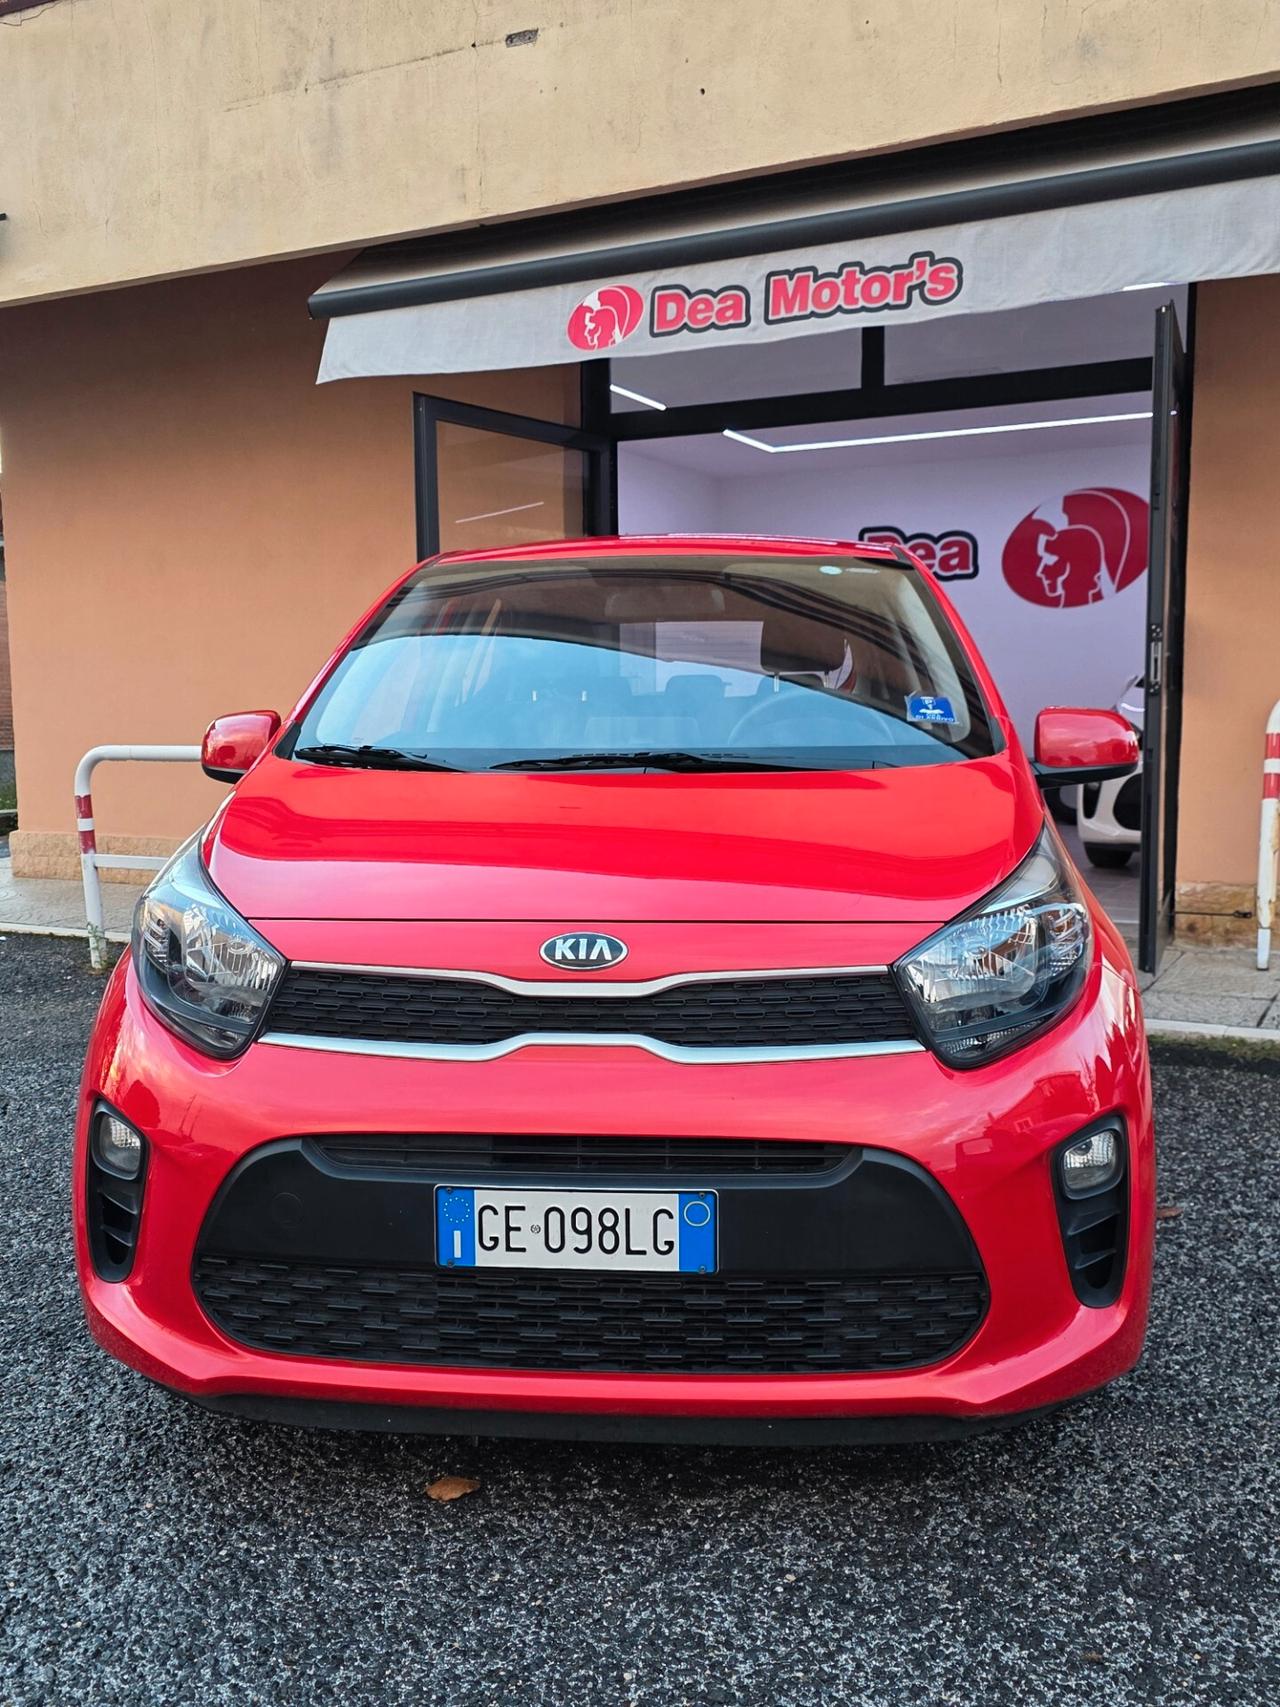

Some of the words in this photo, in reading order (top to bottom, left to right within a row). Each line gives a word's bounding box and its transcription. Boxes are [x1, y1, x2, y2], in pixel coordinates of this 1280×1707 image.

[652, 286, 748, 336] Dea
[766, 253, 961, 323] Motor's
[861, 529, 976, 579] ea
[554, 938, 612, 961] KIA
